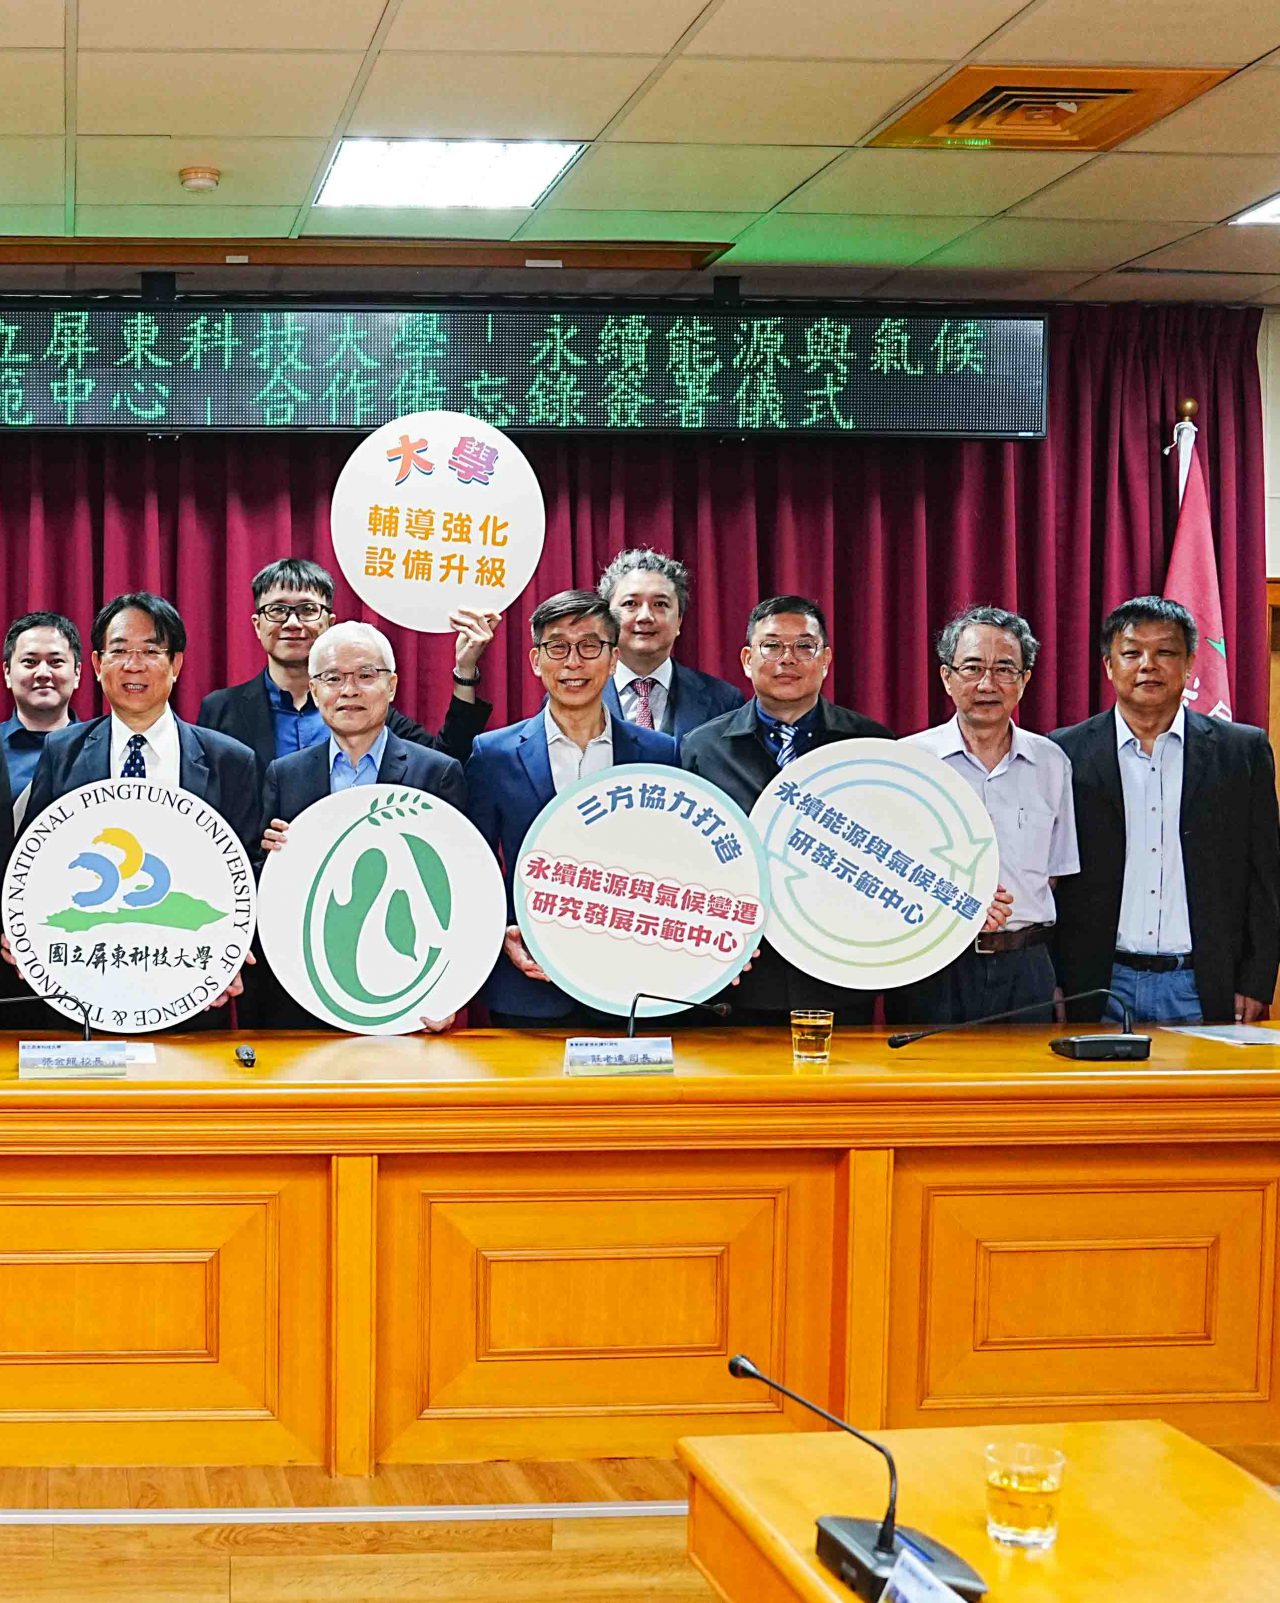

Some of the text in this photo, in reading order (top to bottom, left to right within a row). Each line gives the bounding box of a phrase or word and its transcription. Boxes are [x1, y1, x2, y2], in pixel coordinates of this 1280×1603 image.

[387, 434, 499, 486] 大學
[368, 504, 509, 547] 輔導強化
[364, 546, 506, 588] 設備升級
[79, 784, 194, 816] PINGTUNG
[577, 783, 743, 864] 三方協力打造
[9, 805, 75, 902] NATIONAL
[195, 810, 251, 934] UNIVERSITY
[774, 781, 983, 921] 永續能源與氣候變遷
[787, 828, 924, 925] 研發示範中心
[525, 857, 759, 925] 永續能源與氣候變遷
[532, 891, 738, 953] 研究發展示範中心
[48, 942, 213, 976] 國立屏東科技大學
[220, 943, 242, 974] OF
[112, 1010, 128, 1026] &
[135, 975, 220, 1026] SCIENCE
